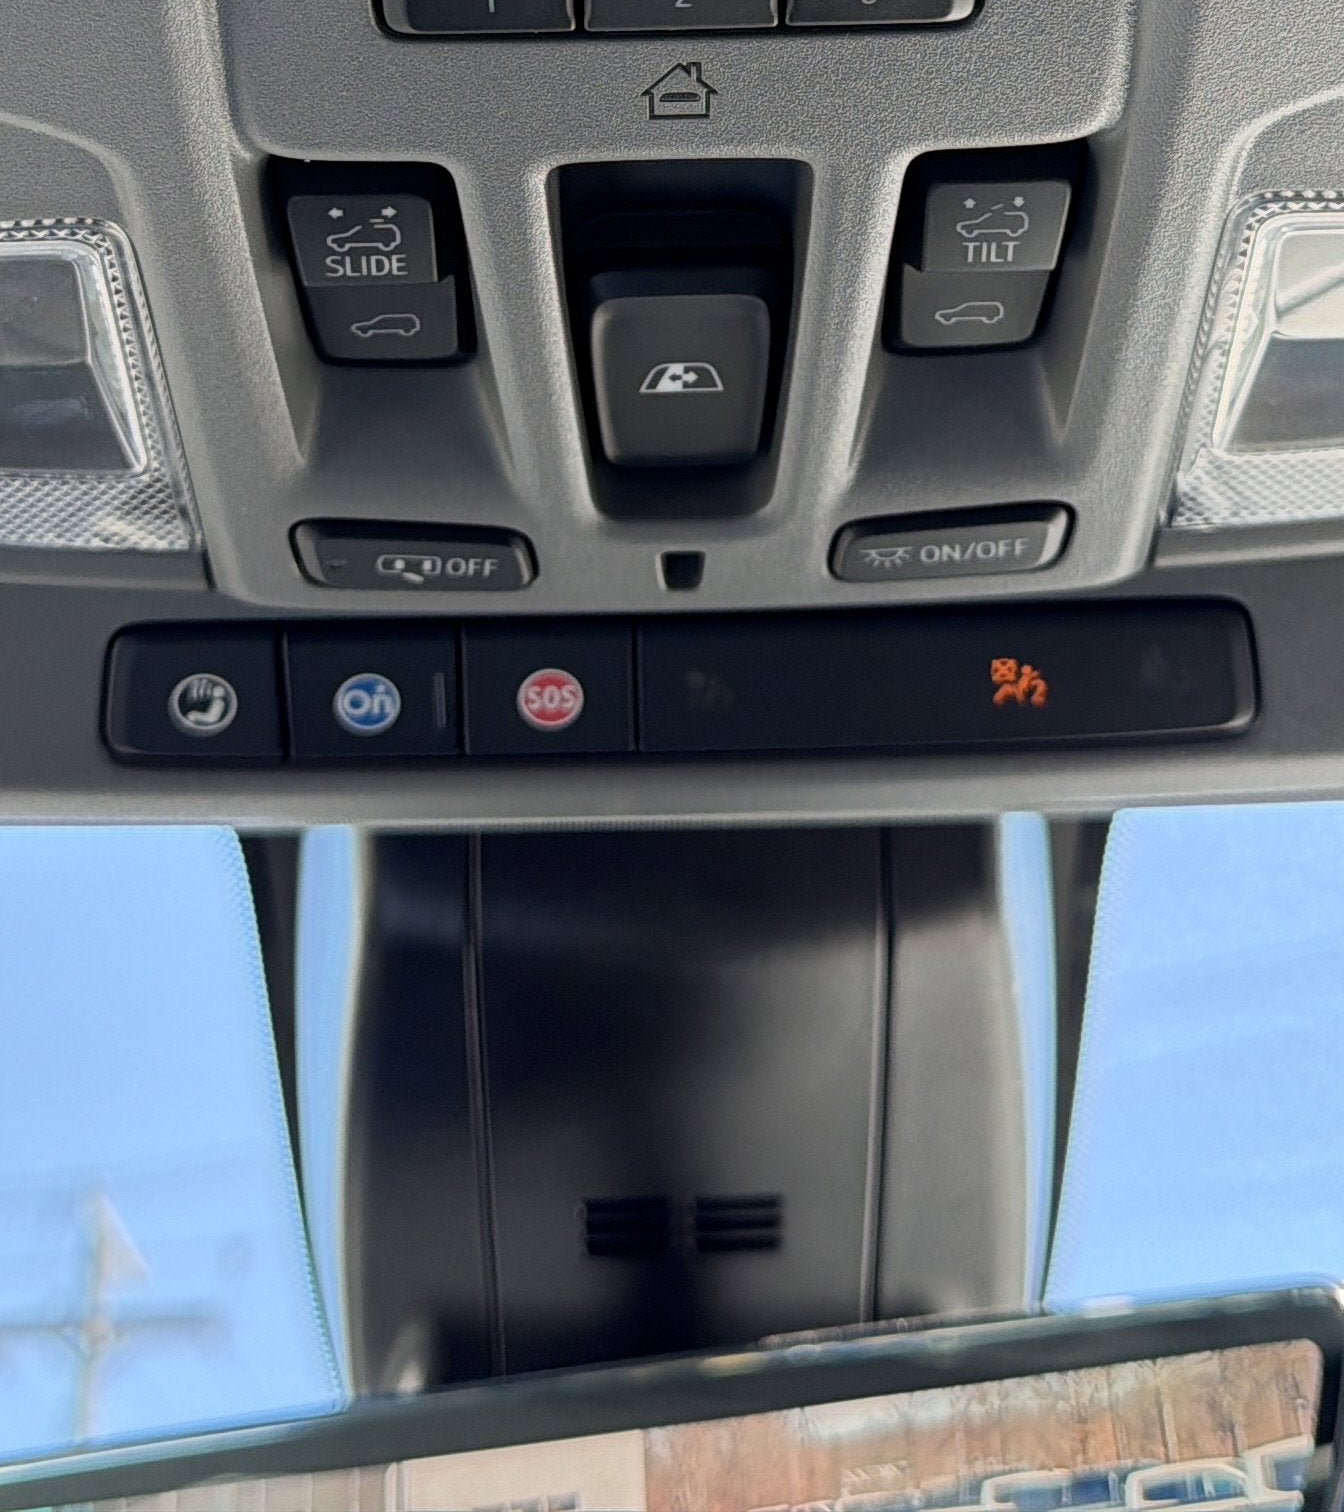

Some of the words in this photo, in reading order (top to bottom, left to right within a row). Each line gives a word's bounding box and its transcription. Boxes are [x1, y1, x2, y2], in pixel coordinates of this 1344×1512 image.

[961, 241, 1020, 263] TILT
[325, 254, 409, 277] SLIDE
[920, 539, 1029, 563] ON/OFF
[445, 557, 498, 577] OFF
[527, 684, 577, 710] SOS
